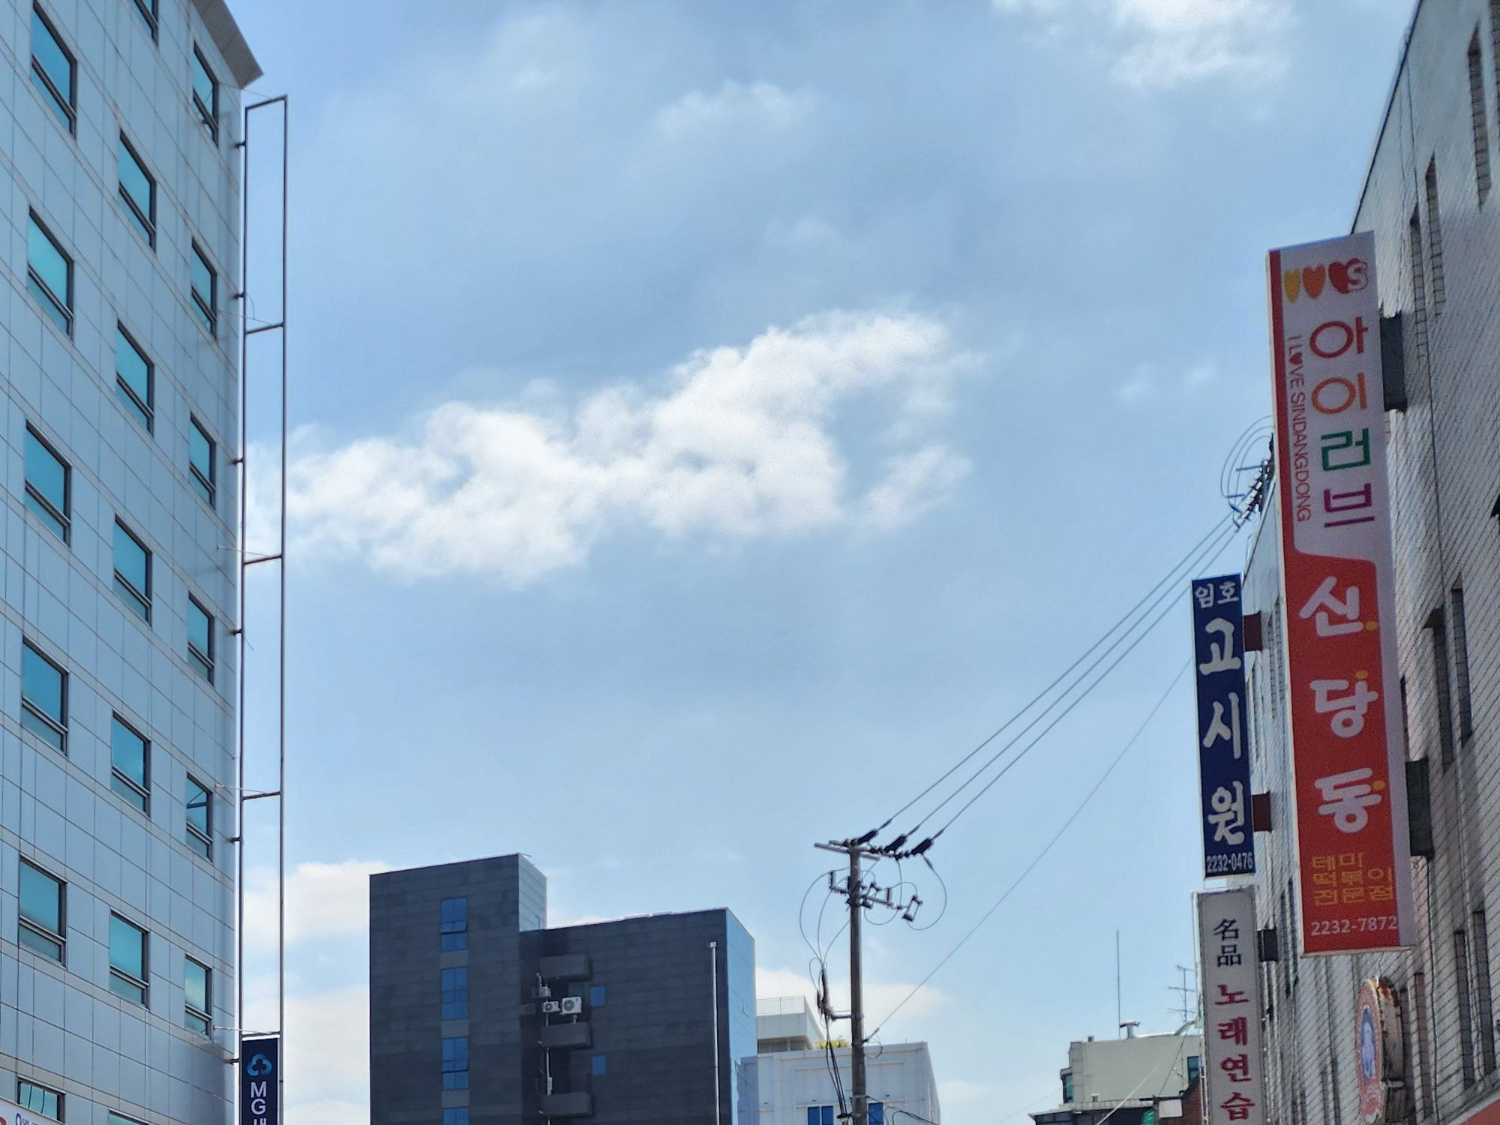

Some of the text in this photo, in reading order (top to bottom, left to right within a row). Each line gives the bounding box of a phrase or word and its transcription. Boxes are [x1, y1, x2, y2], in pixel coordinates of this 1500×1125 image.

[1290, 392, 1312, 523] SINDANGDONG
[1200, 620, 1246, 846] 고시원
[1299, 574, 1390, 835] 신당동
[1205, 851, 1255, 875] 2232-0476
[1213, 918, 1243, 967] 名品
[1311, 916, 1398, 936] 2232-7872
